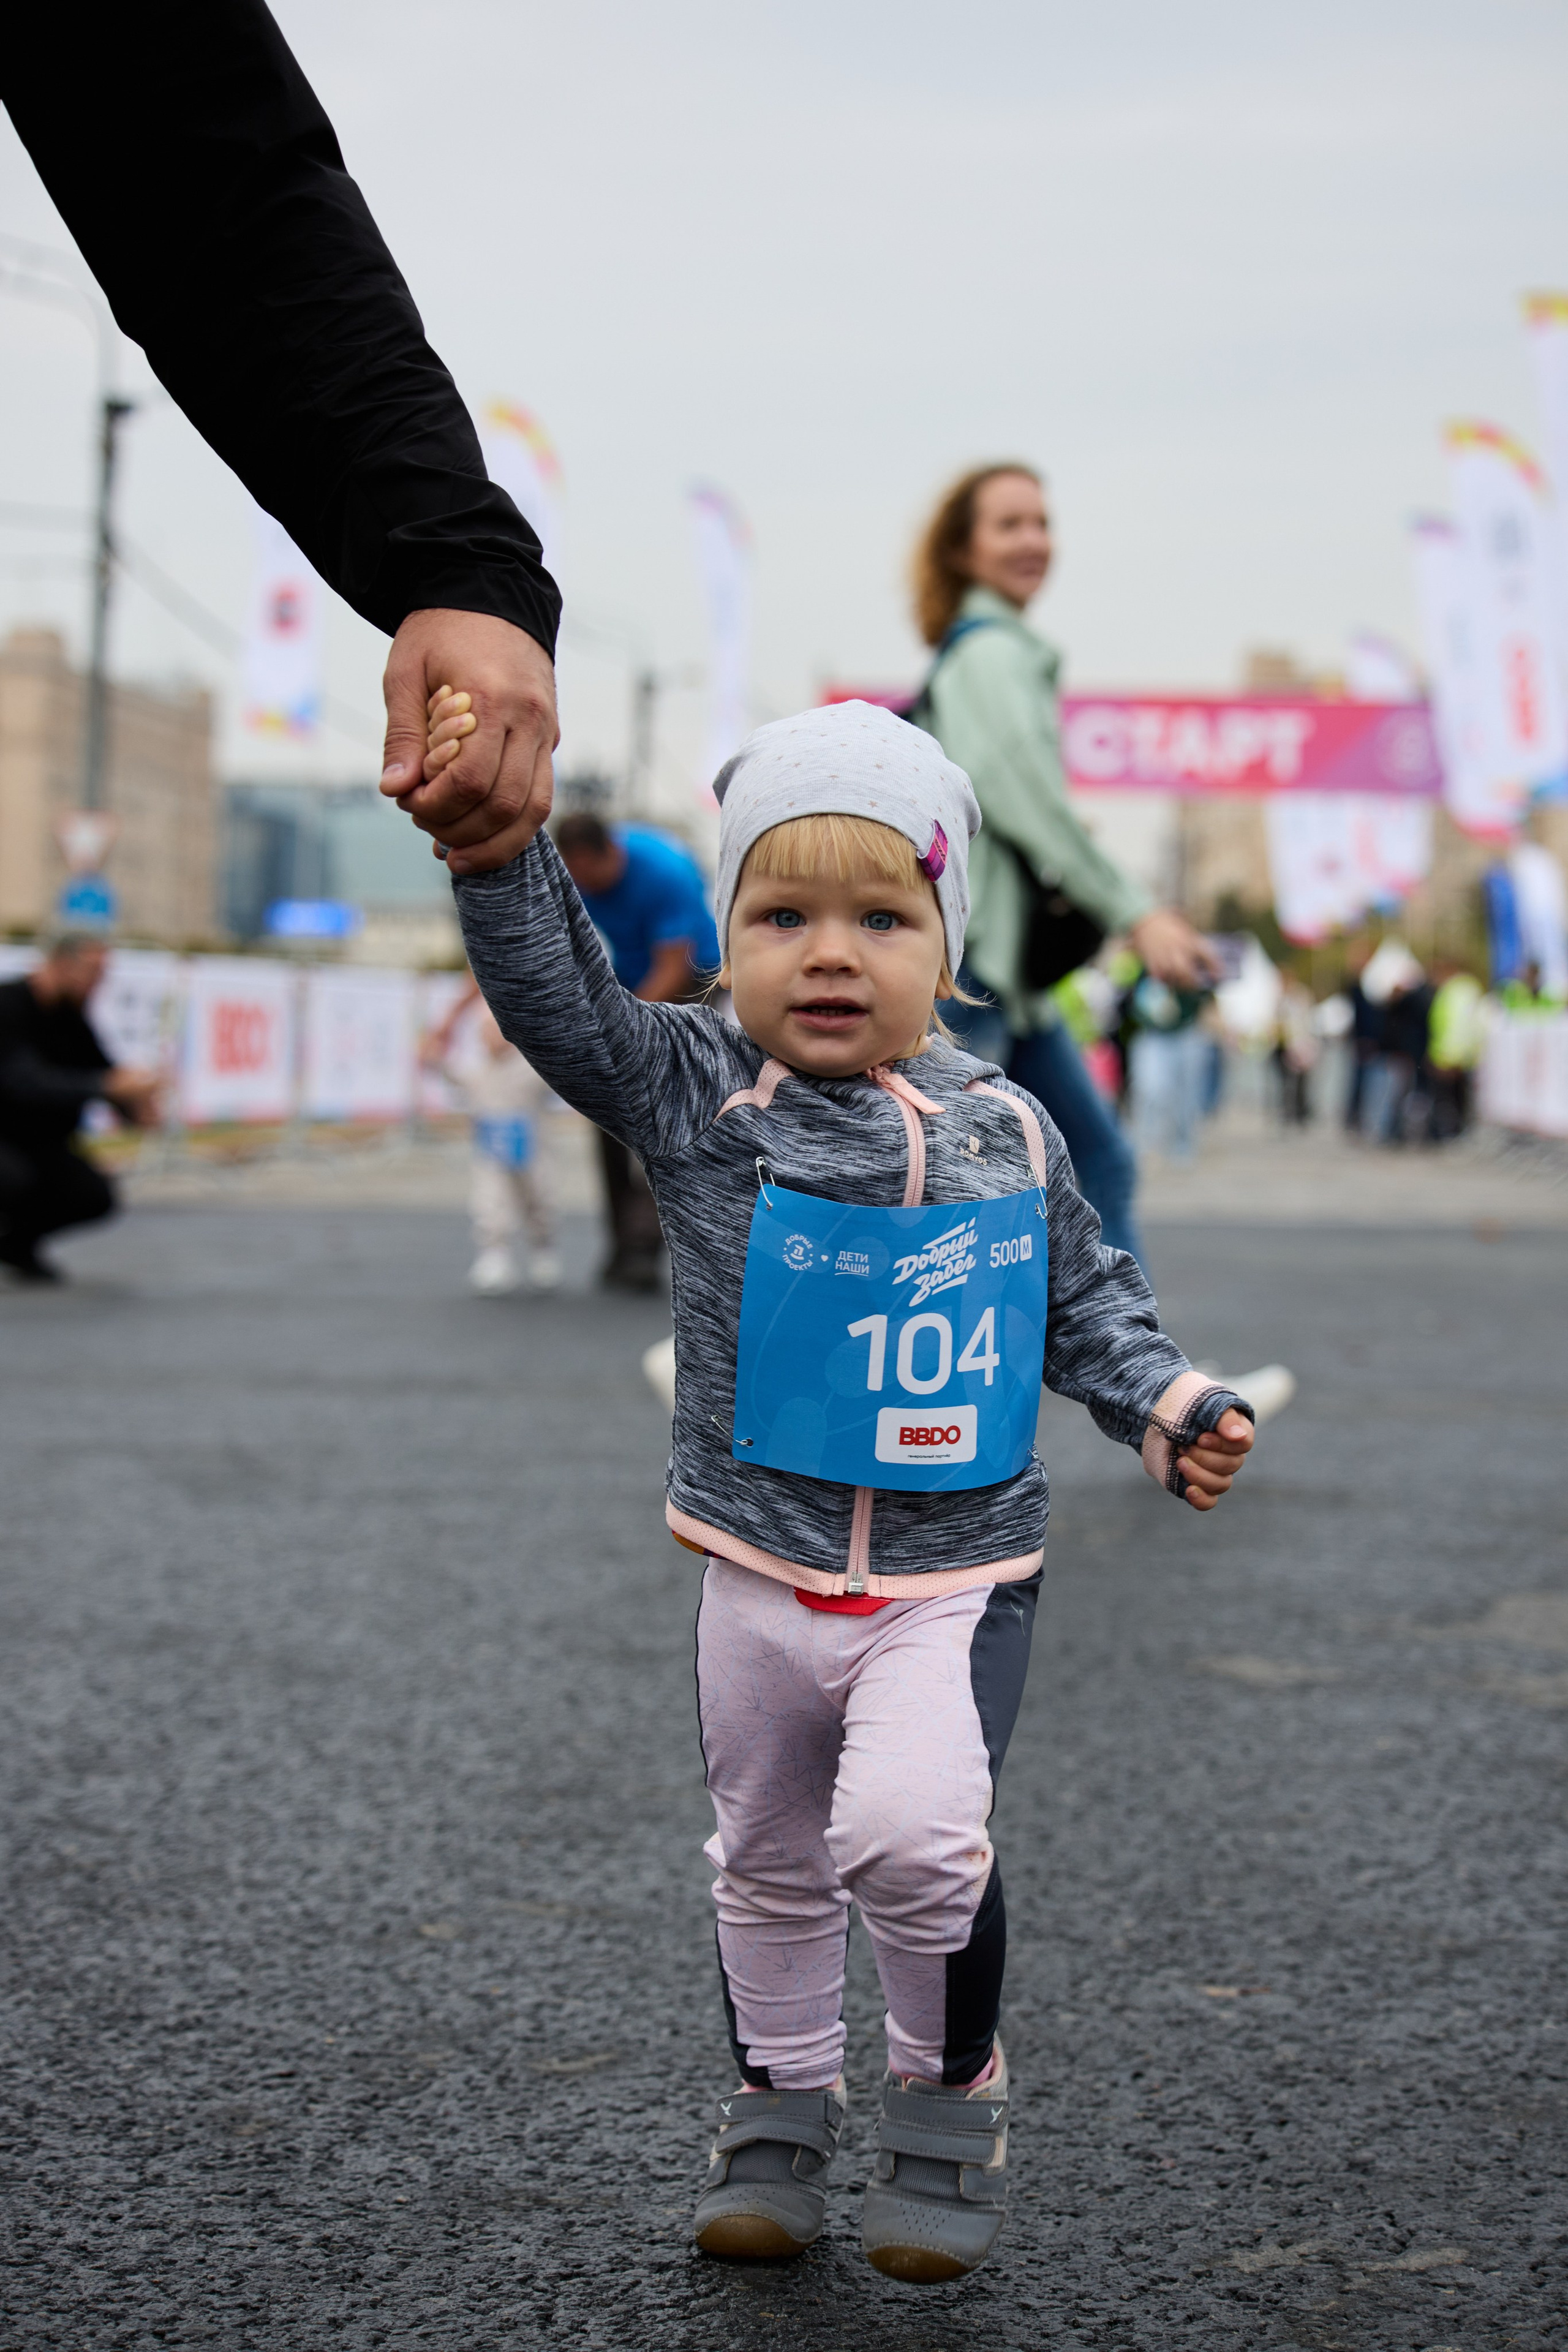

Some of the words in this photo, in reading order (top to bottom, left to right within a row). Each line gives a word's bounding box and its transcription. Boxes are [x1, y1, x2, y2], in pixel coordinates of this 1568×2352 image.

[1063, 703, 1312, 782] СТАРТ
[960, 1148, 988, 1166] DOMYOS
[785, 1234, 813, 1250] ДОБРЫЕ
[892, 1216, 979, 1285] Добрый
[782, 1254, 813, 1271] ПРОЕКТЫ
[837, 1250, 869, 1264] ДЕТИ
[835, 1261, 870, 1275] НАШИ
[847, 1306, 1000, 1395] 104
[899, 1425, 961, 1446] BBDO
